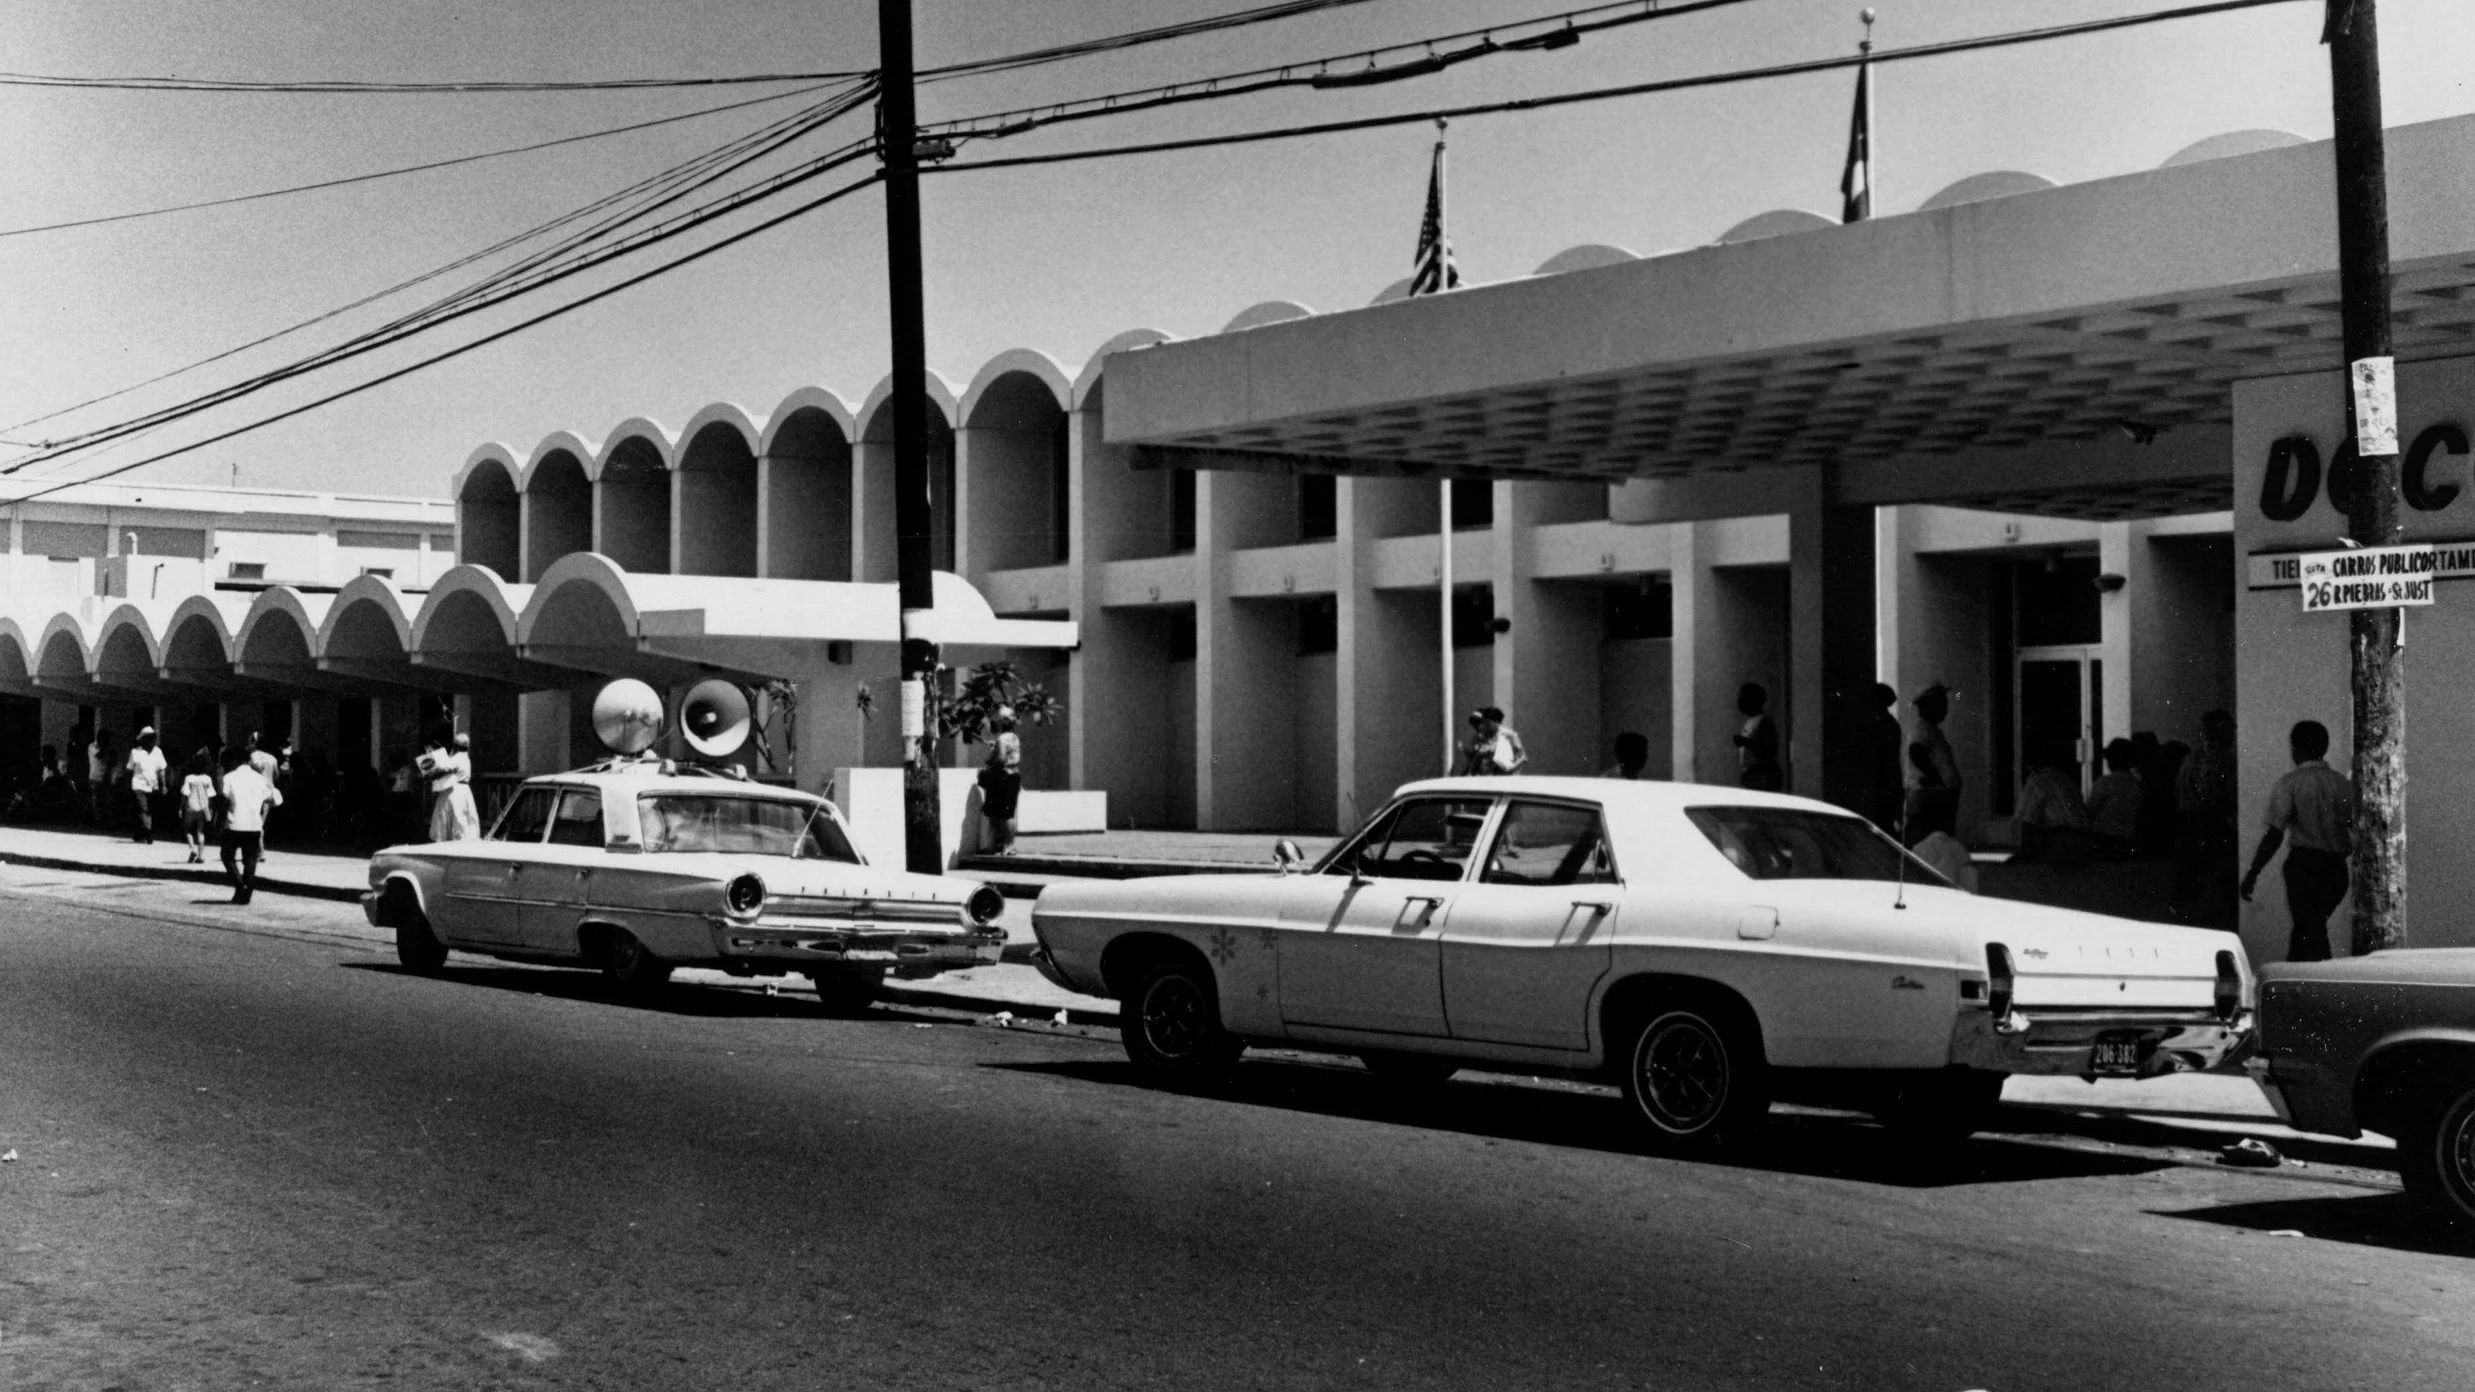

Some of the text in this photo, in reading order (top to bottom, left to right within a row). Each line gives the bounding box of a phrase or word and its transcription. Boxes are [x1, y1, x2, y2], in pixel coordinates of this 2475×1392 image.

[2333, 555, 2376, 578] CARROS
[2307, 581, 2332, 608] 26
[2404, 580, 2432, 601] JUST
